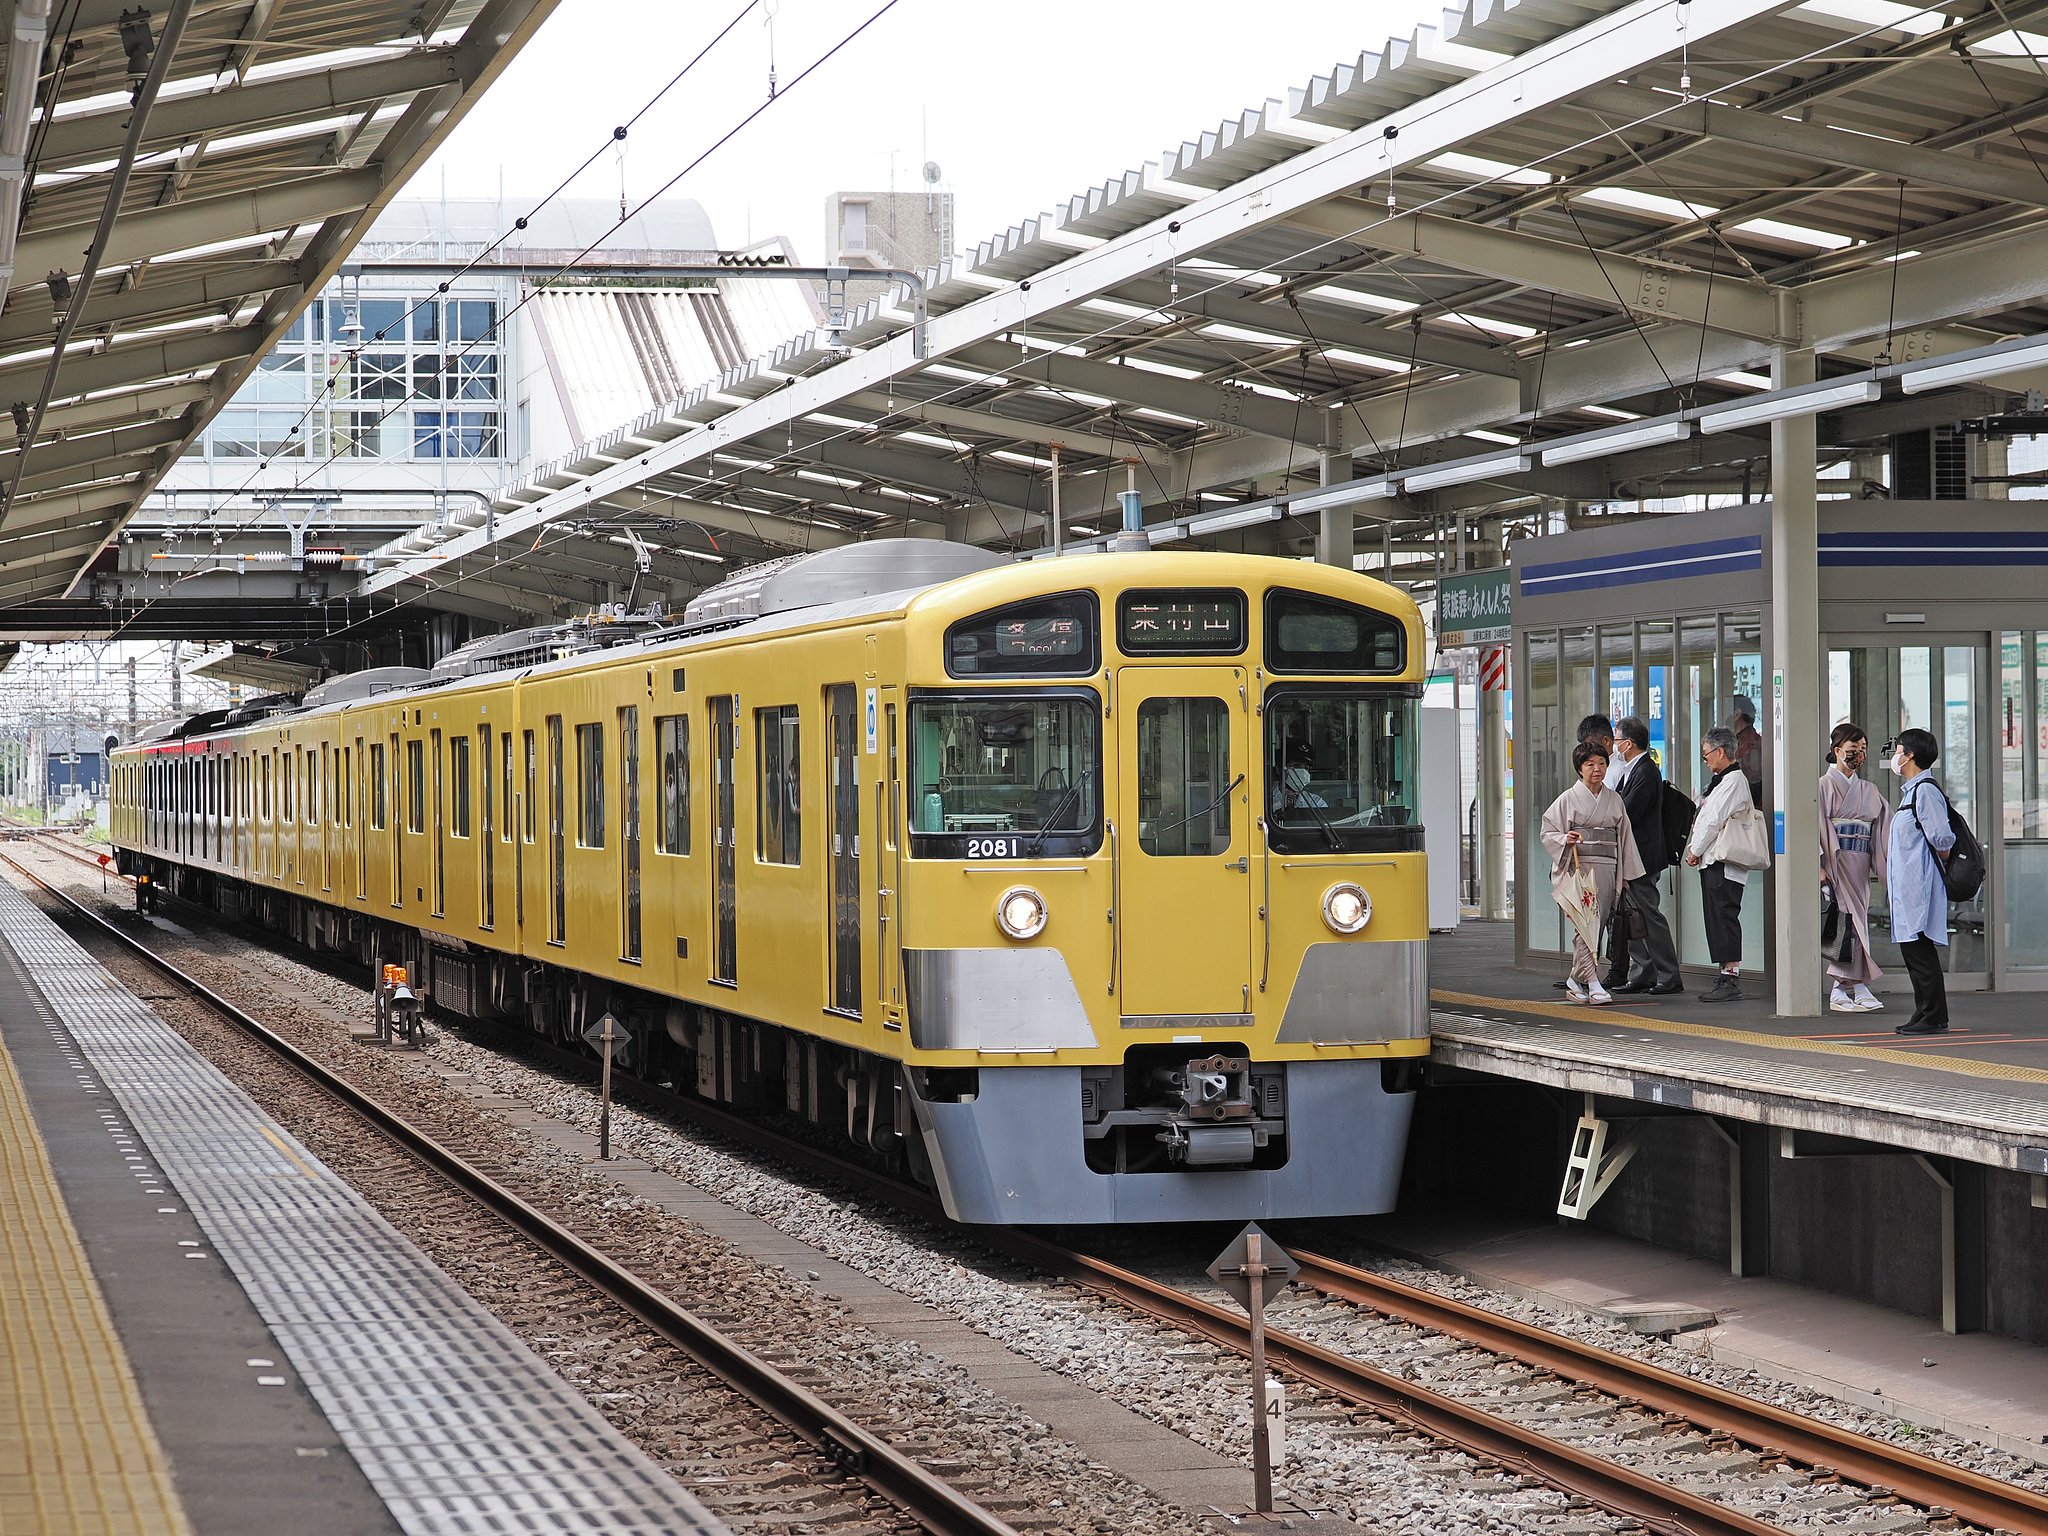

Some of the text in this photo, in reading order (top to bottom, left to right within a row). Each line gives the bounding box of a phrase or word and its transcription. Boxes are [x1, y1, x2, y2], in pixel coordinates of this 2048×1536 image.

[1442, 583, 1511, 620] 家族葬のあんしん祭
[1774, 702, 1782, 741] 小川
[968, 839, 1017, 857] 2081
[1266, 1399, 1282, 1419] 4
